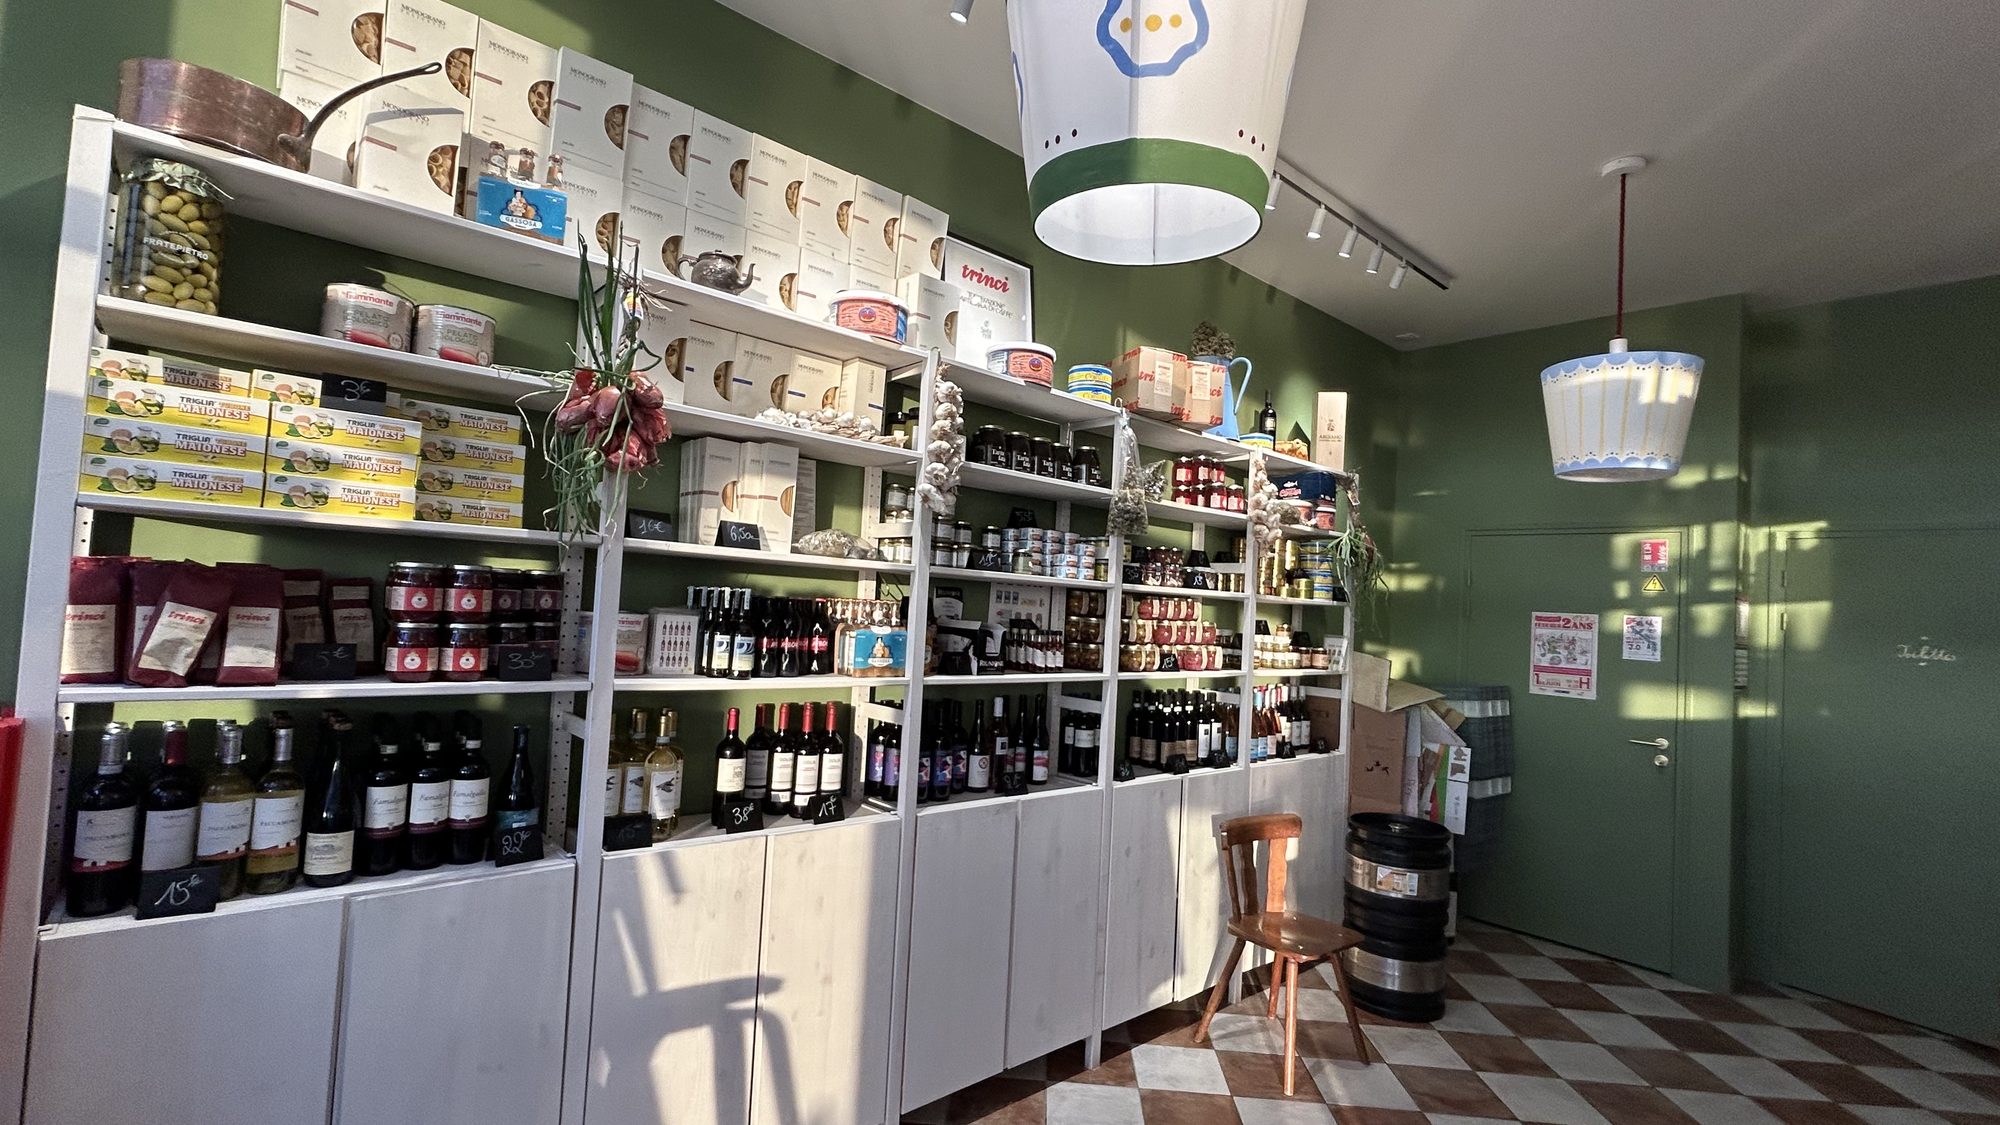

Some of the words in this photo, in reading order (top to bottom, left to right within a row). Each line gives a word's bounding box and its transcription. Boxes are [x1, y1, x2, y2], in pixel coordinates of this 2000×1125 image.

[297, 96, 348, 117] MONONO
[505, 217, 538, 228] GASSOSA
[143, 237, 209, 261] FRATEPIETRO
[962, 265, 1010, 293] trinci
[163, 366, 198, 377] TRIGLIA
[163, 373, 232, 392] MAIONESE
[180, 396, 215, 407] TRIGLIA
[179, 403, 250, 421] MAIONESE
[460, 413, 484, 422] TRIGLIA
[346, 418, 376, 429] TRIGLIA
[459, 419, 508, 432] MAIONESE
[176, 433, 210, 443] TRIGLIA
[345, 425, 405, 441] MAIONESE
[174, 440, 247, 456] MAIONESE
[465, 444, 489, 452] TRIGLIA
[343, 453, 373, 462] TRIGLIA
[465, 449, 513, 463] MAIONESE
[342, 460, 401, 474] MAIONESE
[173, 470, 207, 480] TRIGLIA
[464, 473, 487, 481] TRIGLIA
[171, 478, 243, 493] MAIONESE
[342, 487, 371, 496] TRIGLIA
[463, 479, 511, 492] MAIONESE
[341, 494, 400, 507] MAIONESE
[461, 509, 510, 521] MAIONESE
[168, 611, 207, 626] trinci
[236, 611, 271, 623] trinci
[1572, 621, 1593, 630] ANS
[732, 802, 755, 824] 38€
